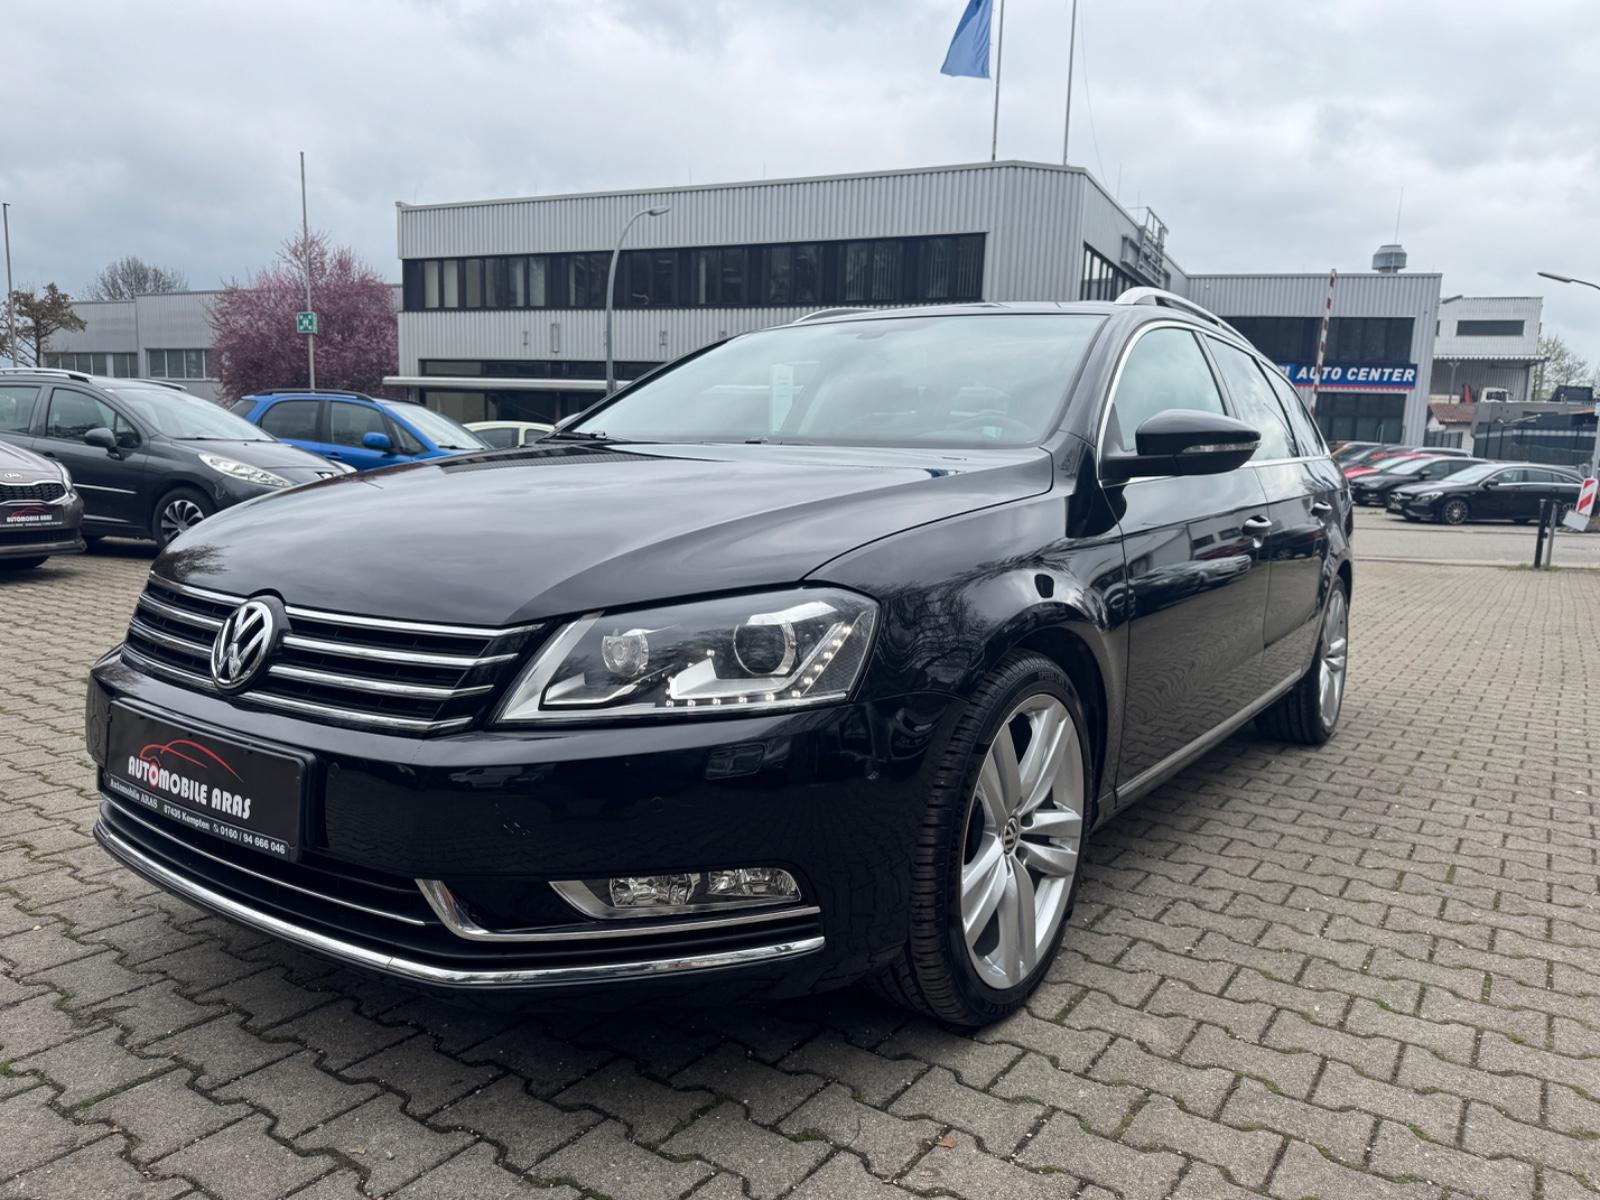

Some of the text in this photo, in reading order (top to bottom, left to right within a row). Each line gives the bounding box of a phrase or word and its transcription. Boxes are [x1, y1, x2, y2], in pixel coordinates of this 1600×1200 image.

[1296, 366, 1342, 381] AUTO
[1347, 367, 1415, 382] CENTER
[128, 755, 252, 819] AUTOMOBILE ARAS
[181, 811, 210, 831] Kempten
[220, 825, 238, 840] 0160
[243, 833, 253, 845] 94
[254, 836, 269, 849] 666
[270, 841, 286, 855] 046
